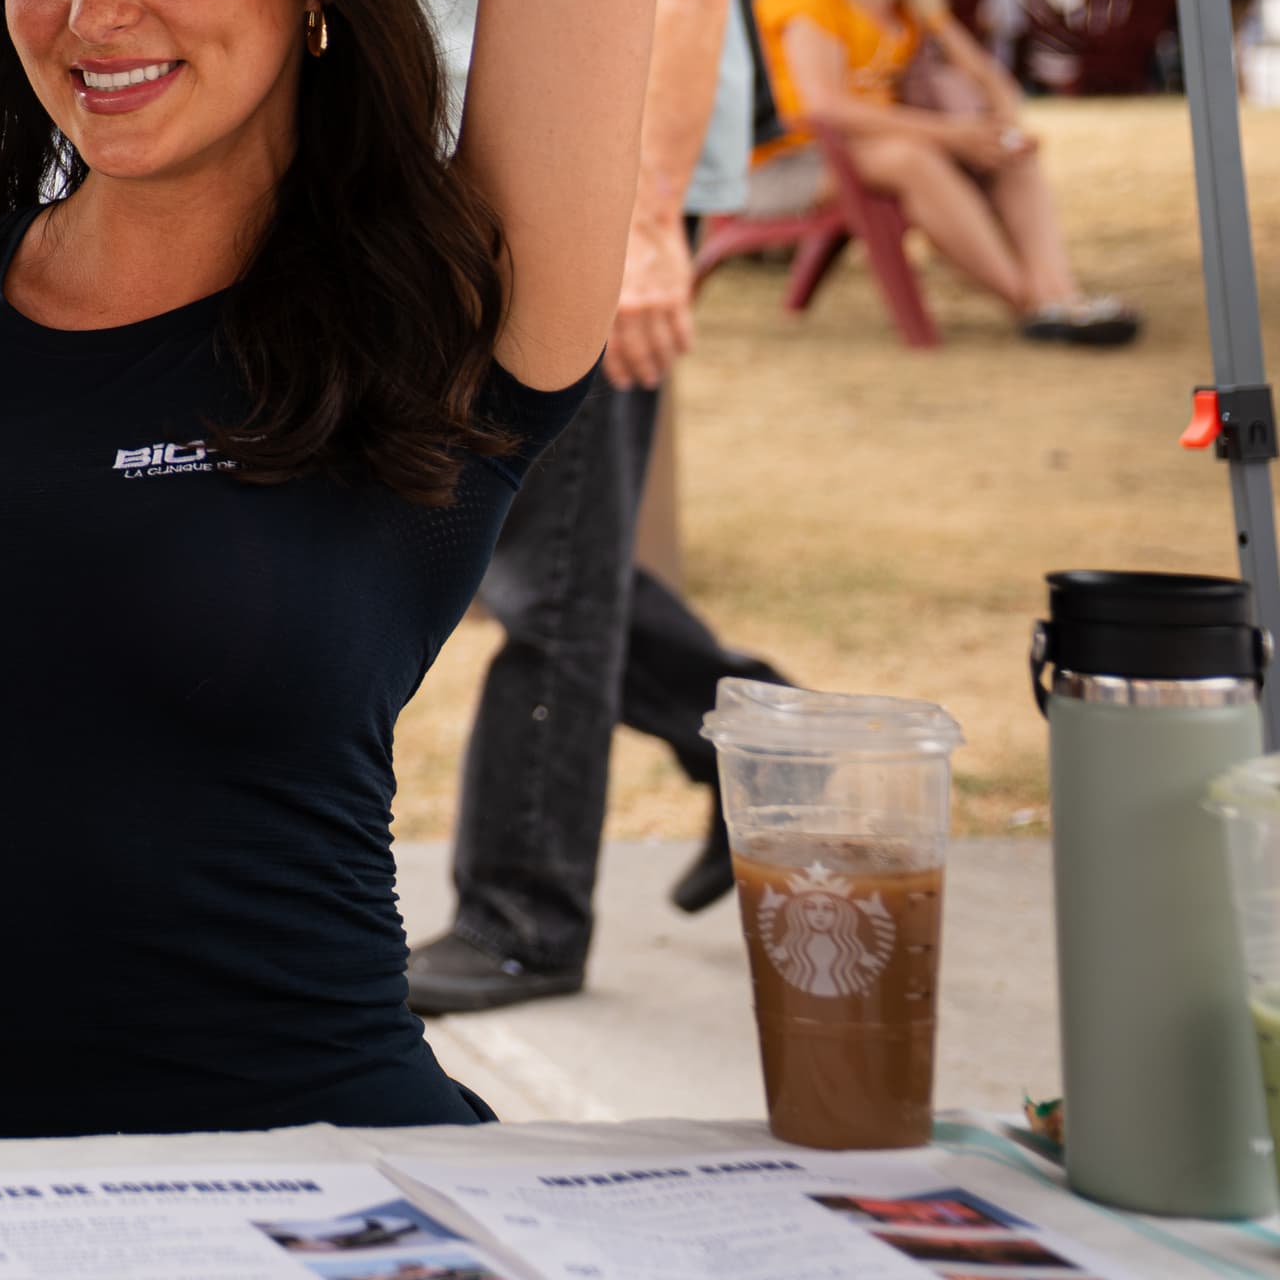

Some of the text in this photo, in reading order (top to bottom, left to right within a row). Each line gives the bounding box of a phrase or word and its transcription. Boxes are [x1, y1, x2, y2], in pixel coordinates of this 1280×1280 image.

[124, 470, 143, 478] LA
[147, 463, 213, 476] CLINIQUE
[52, 1183, 92, 1197] DE
[100, 1180, 324, 1196] COMPRESSION
